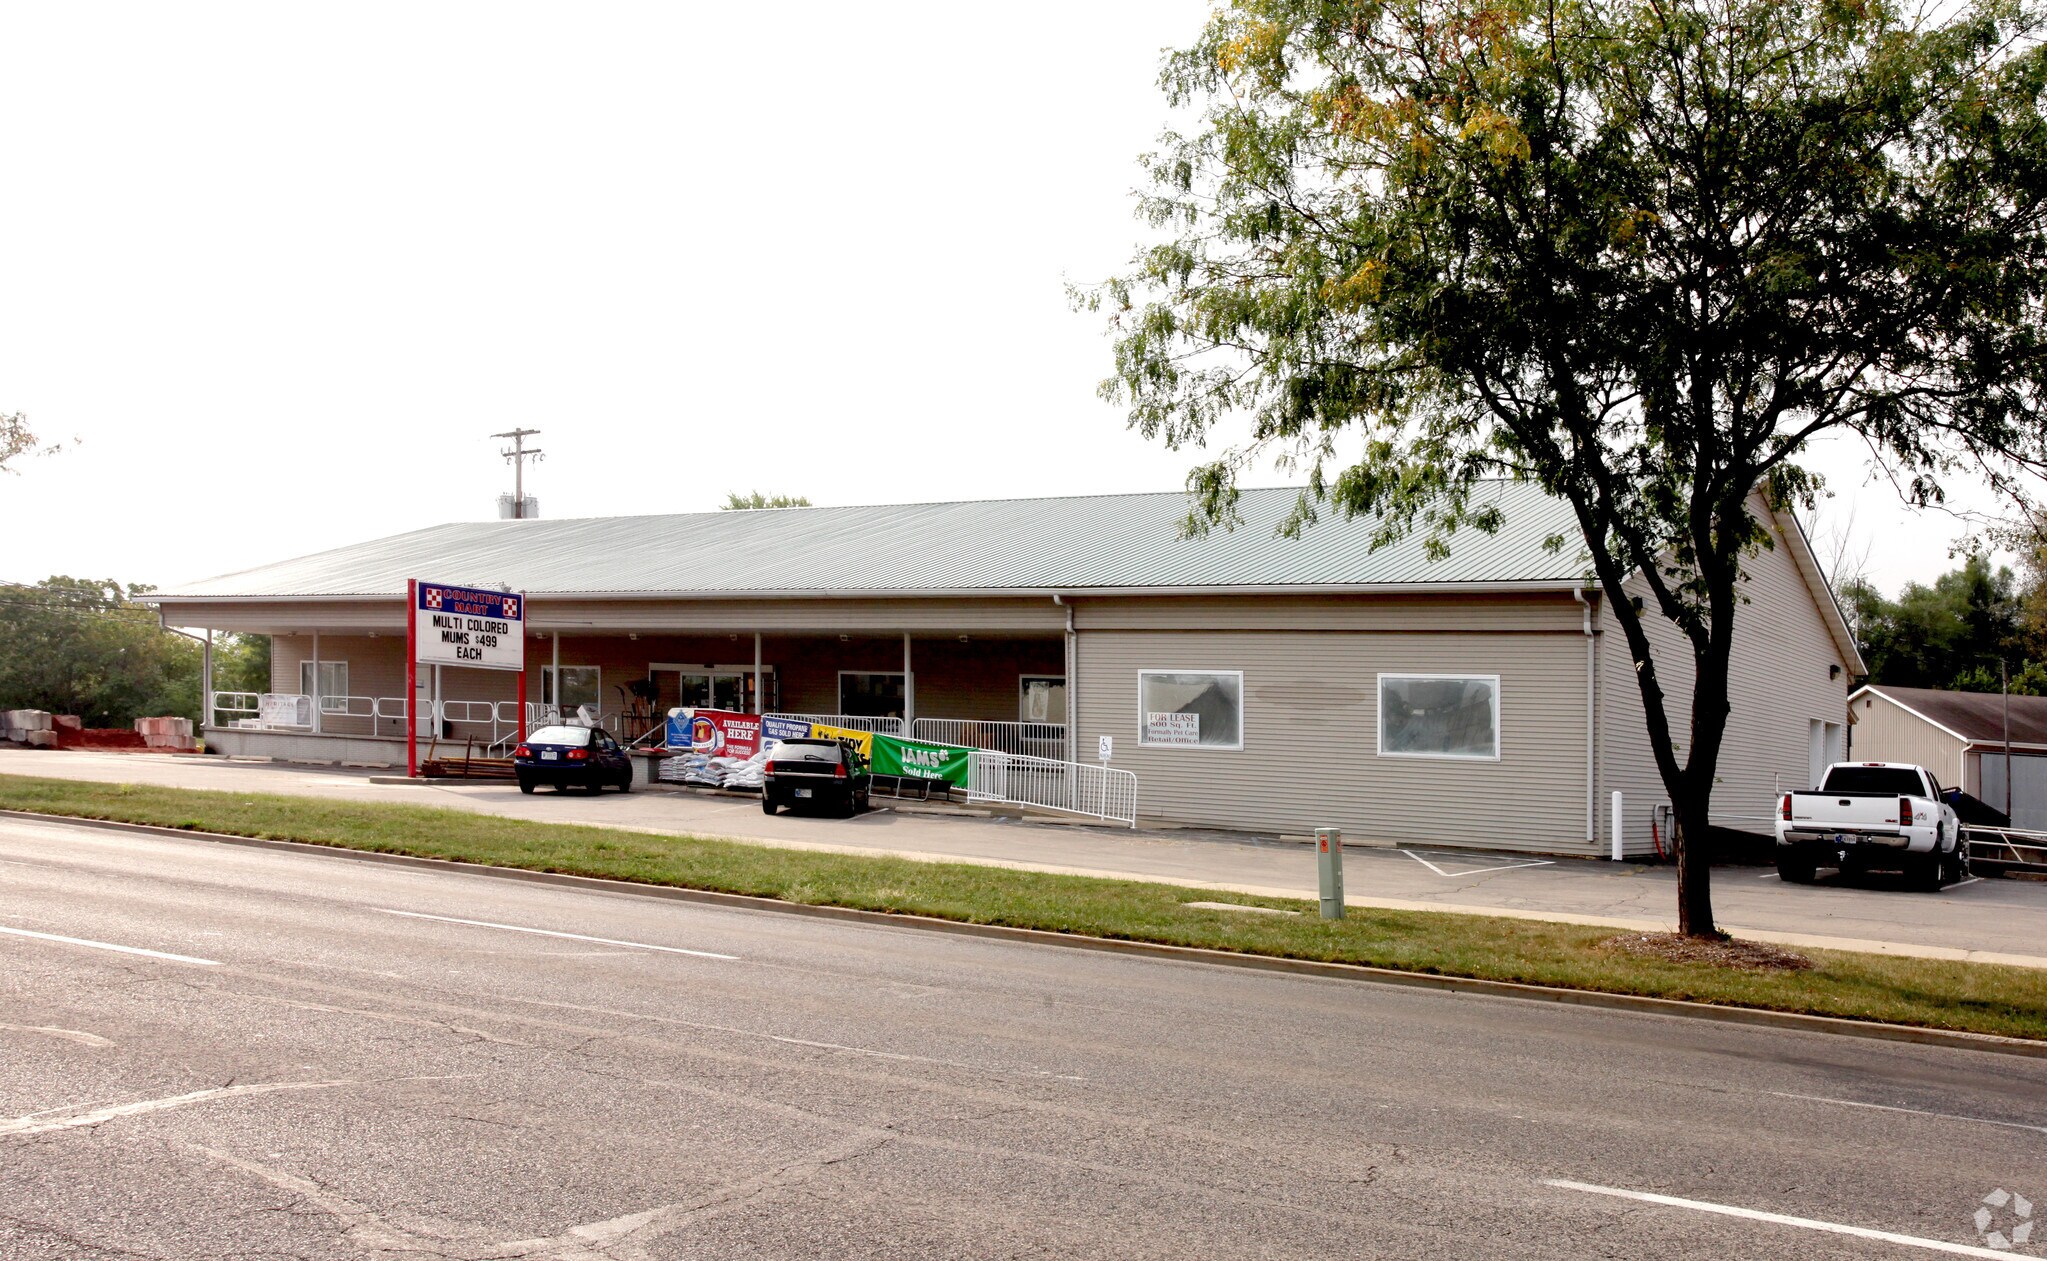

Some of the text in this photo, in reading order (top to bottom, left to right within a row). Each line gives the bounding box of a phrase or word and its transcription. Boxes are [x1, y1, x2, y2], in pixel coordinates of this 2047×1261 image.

[443, 589, 502, 605] COUNTRY
[455, 602, 488, 615] MART
[433, 615, 508, 634] MULTI COLORED
[442, 630, 469, 645] MUMS
[457, 646, 482, 660] EACH
[1150, 713, 1196, 722] FOR LEASE
[723, 720, 759, 730] AVAILABLE
[765, 720, 808, 733] QUALITY PROPANE
[727, 728, 754, 740] HERE
[768, 727, 805, 739] GAS SOLD HERE
[838, 736, 863, 752] DY
[901, 746, 939, 768] IAMS
[902, 766, 943, 780] Sold Here
